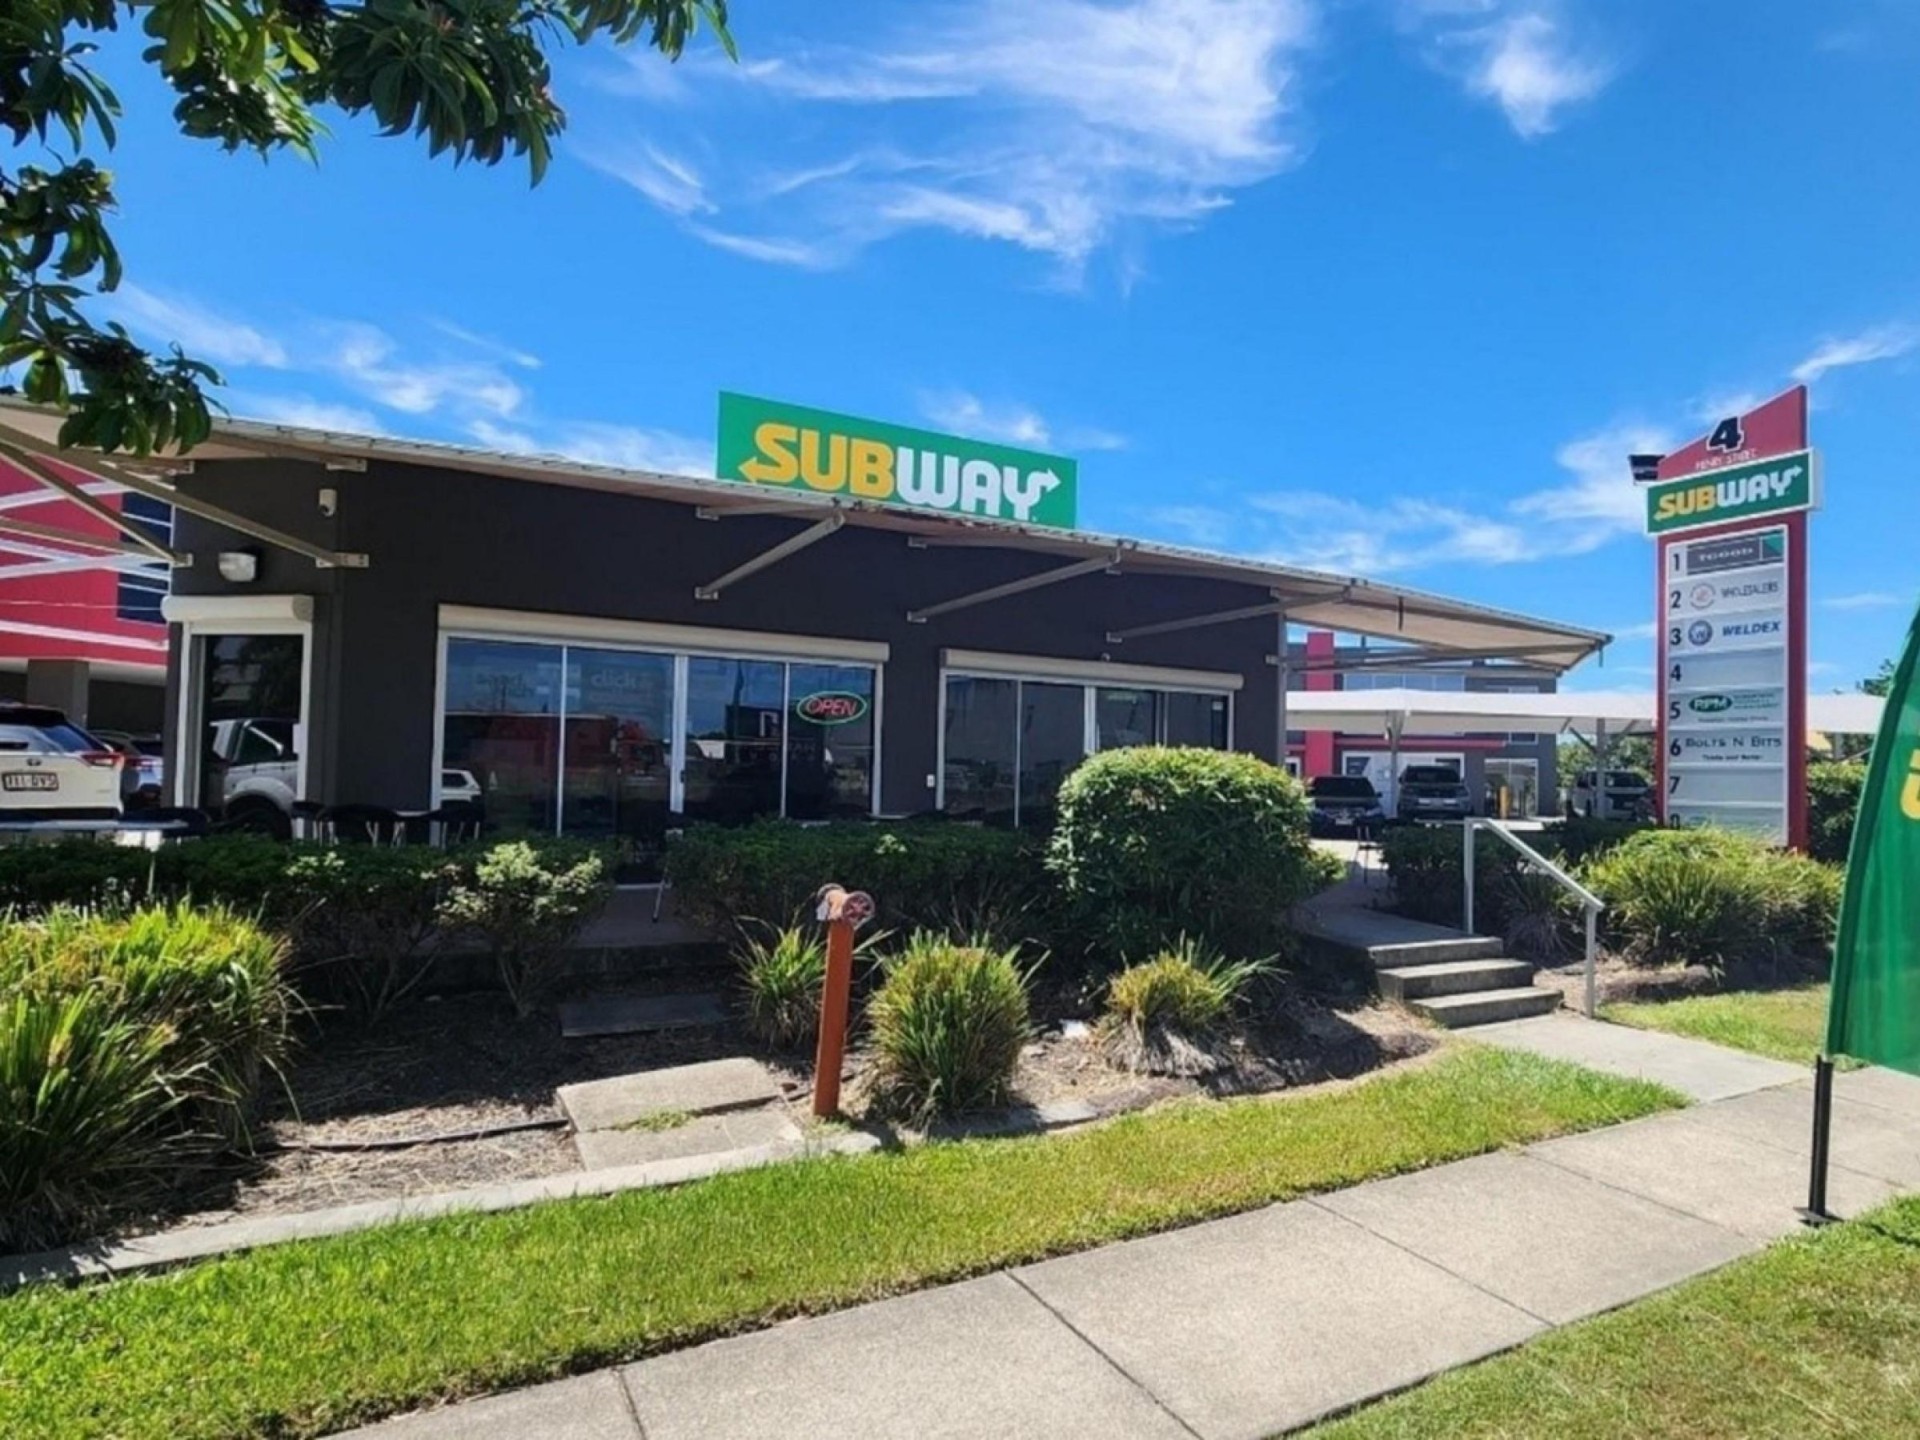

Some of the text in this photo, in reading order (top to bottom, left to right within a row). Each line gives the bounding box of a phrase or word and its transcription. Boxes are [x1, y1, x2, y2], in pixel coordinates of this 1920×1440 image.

[1706, 416, 1744, 453] 4
[738, 422, 1062, 521] SUBWAY
[1654, 465, 1803, 521] SUBWAY
[1672, 553, 1680, 571] 1
[1670, 591, 1682, 609] 2
[1670, 627, 1682, 646] 3
[1722, 621, 1781, 637] WELDEX
[1670, 664, 1682, 682] 4
[806, 697, 858, 716] OPEN
[1669, 701, 1681, 719] 5
[1670, 738, 1682, 756] 6
[1732, 736, 1744, 747] N
[1751, 735, 1782, 748] BITS
[1669, 776, 1681, 794] 7
